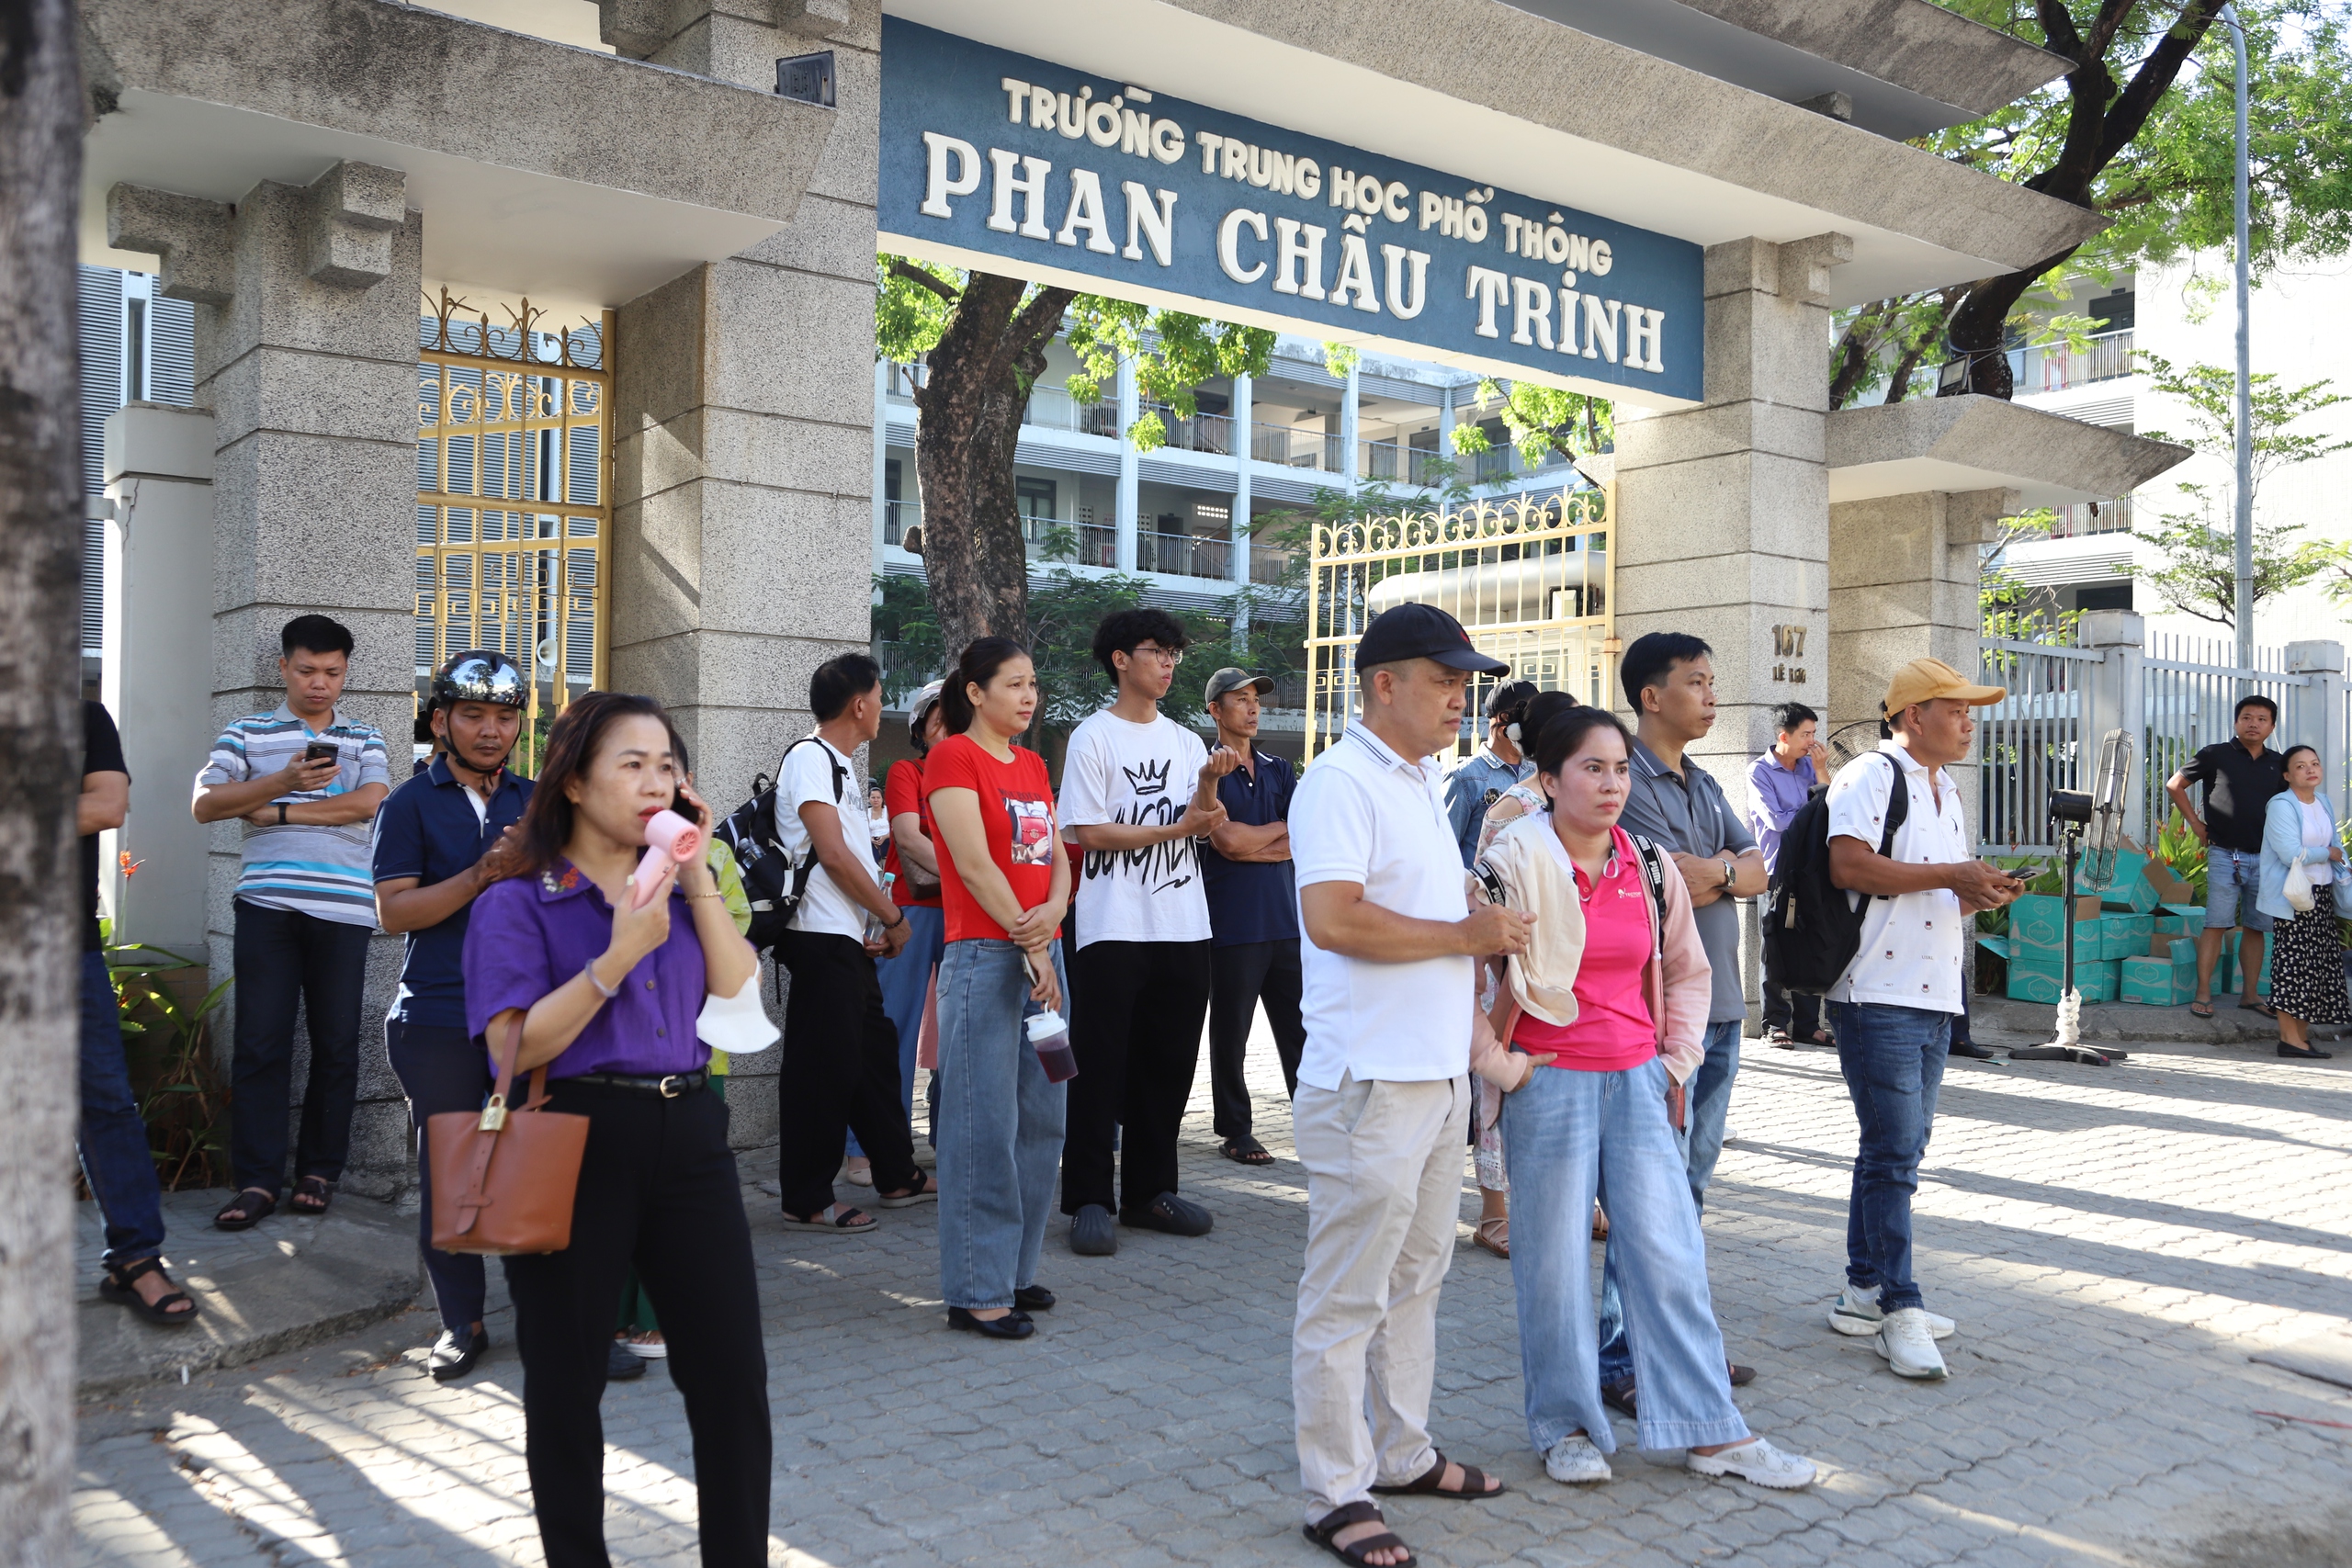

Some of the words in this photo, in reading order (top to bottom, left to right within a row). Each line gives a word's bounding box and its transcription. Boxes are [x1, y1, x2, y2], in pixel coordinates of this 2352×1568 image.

[921, 130, 1178, 266] PHAN
[1216, 208, 1430, 321] CHÂU
[1196, 131, 1321, 200] TRUNG
[1419, 186, 1495, 243] PHỔ
[1501, 210, 1613, 276] THÔNG
[1771, 624, 1807, 658] 167
